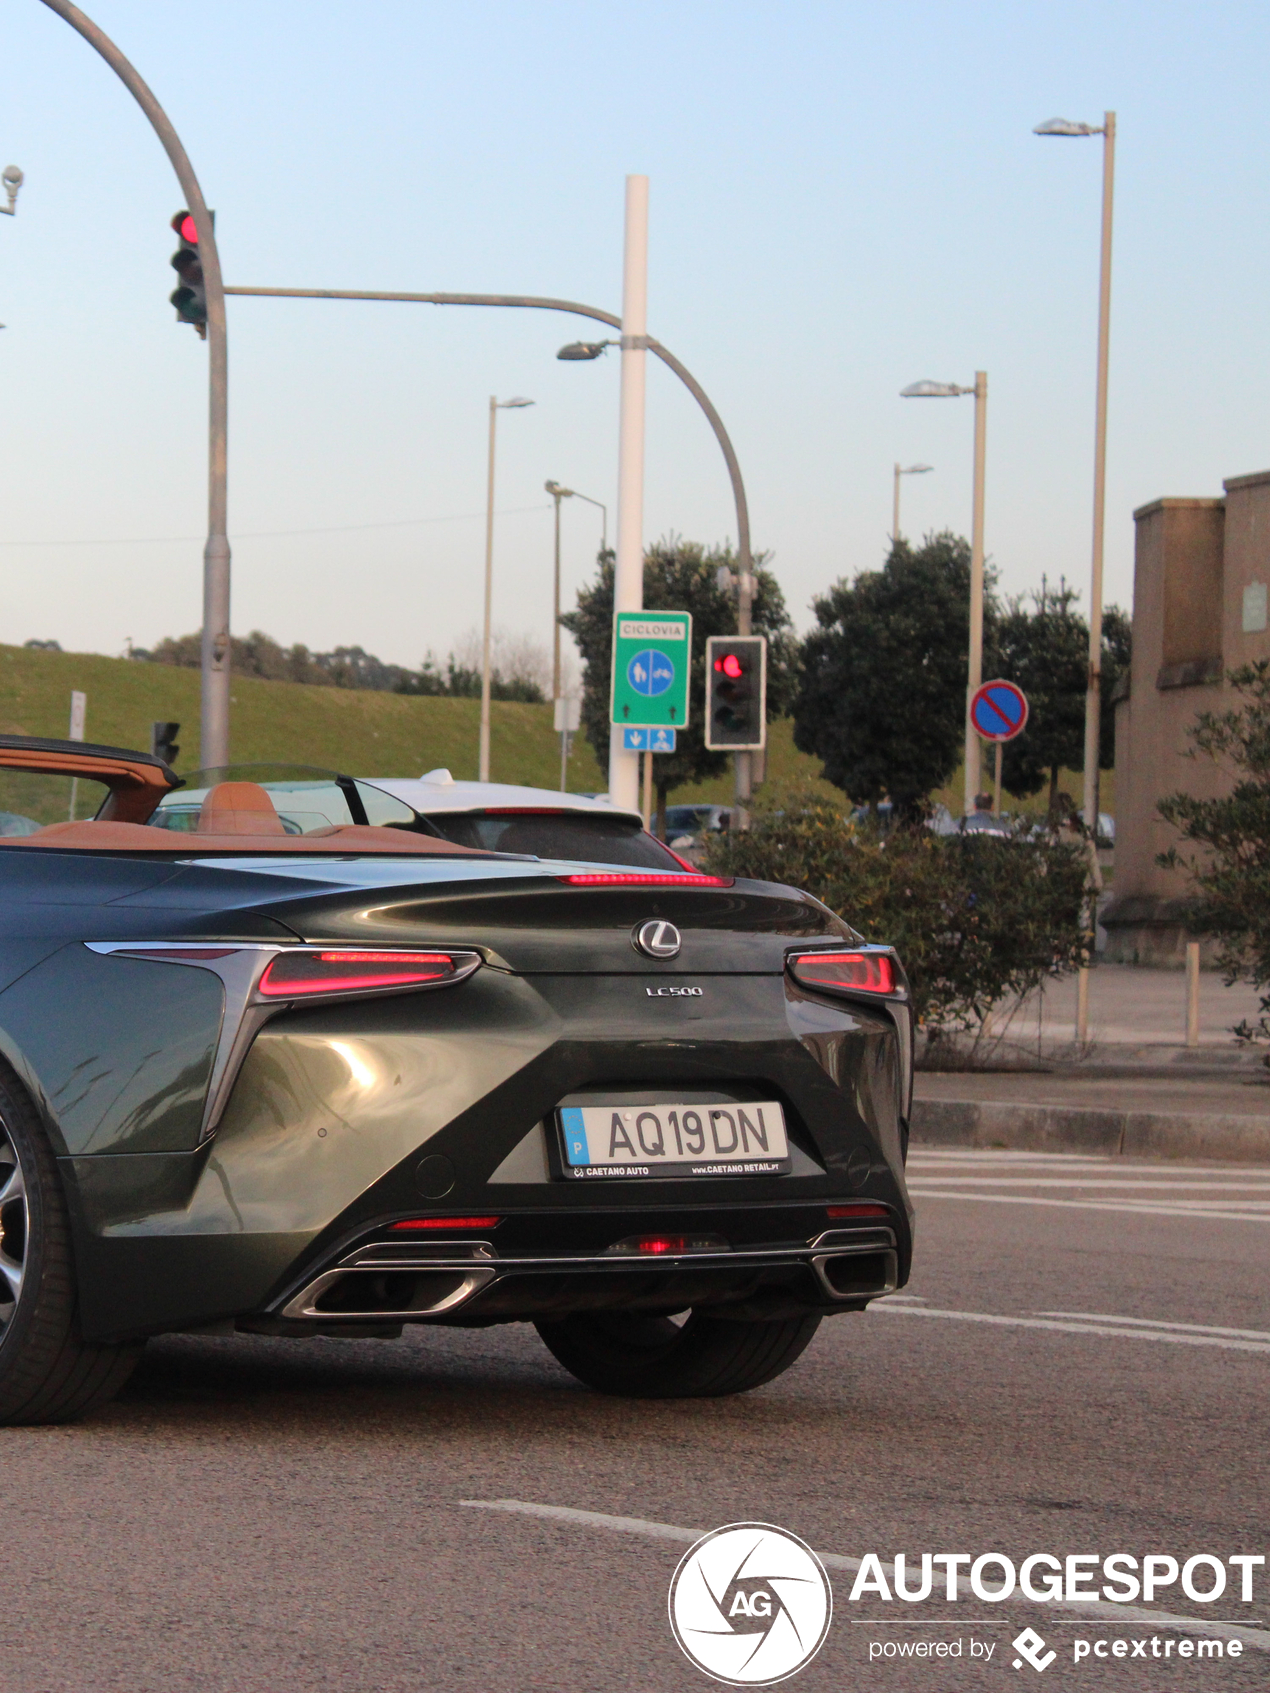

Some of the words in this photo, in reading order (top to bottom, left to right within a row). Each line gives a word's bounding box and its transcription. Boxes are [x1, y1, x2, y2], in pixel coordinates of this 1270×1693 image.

[623, 624, 682, 635] CICLOVIA
[573, 1142, 583, 1155] P
[586, 1168, 625, 1176] CAETANO
[626, 1167, 649, 1175] AUTO
[692, 1165, 743, 1174] www.CAETANO
